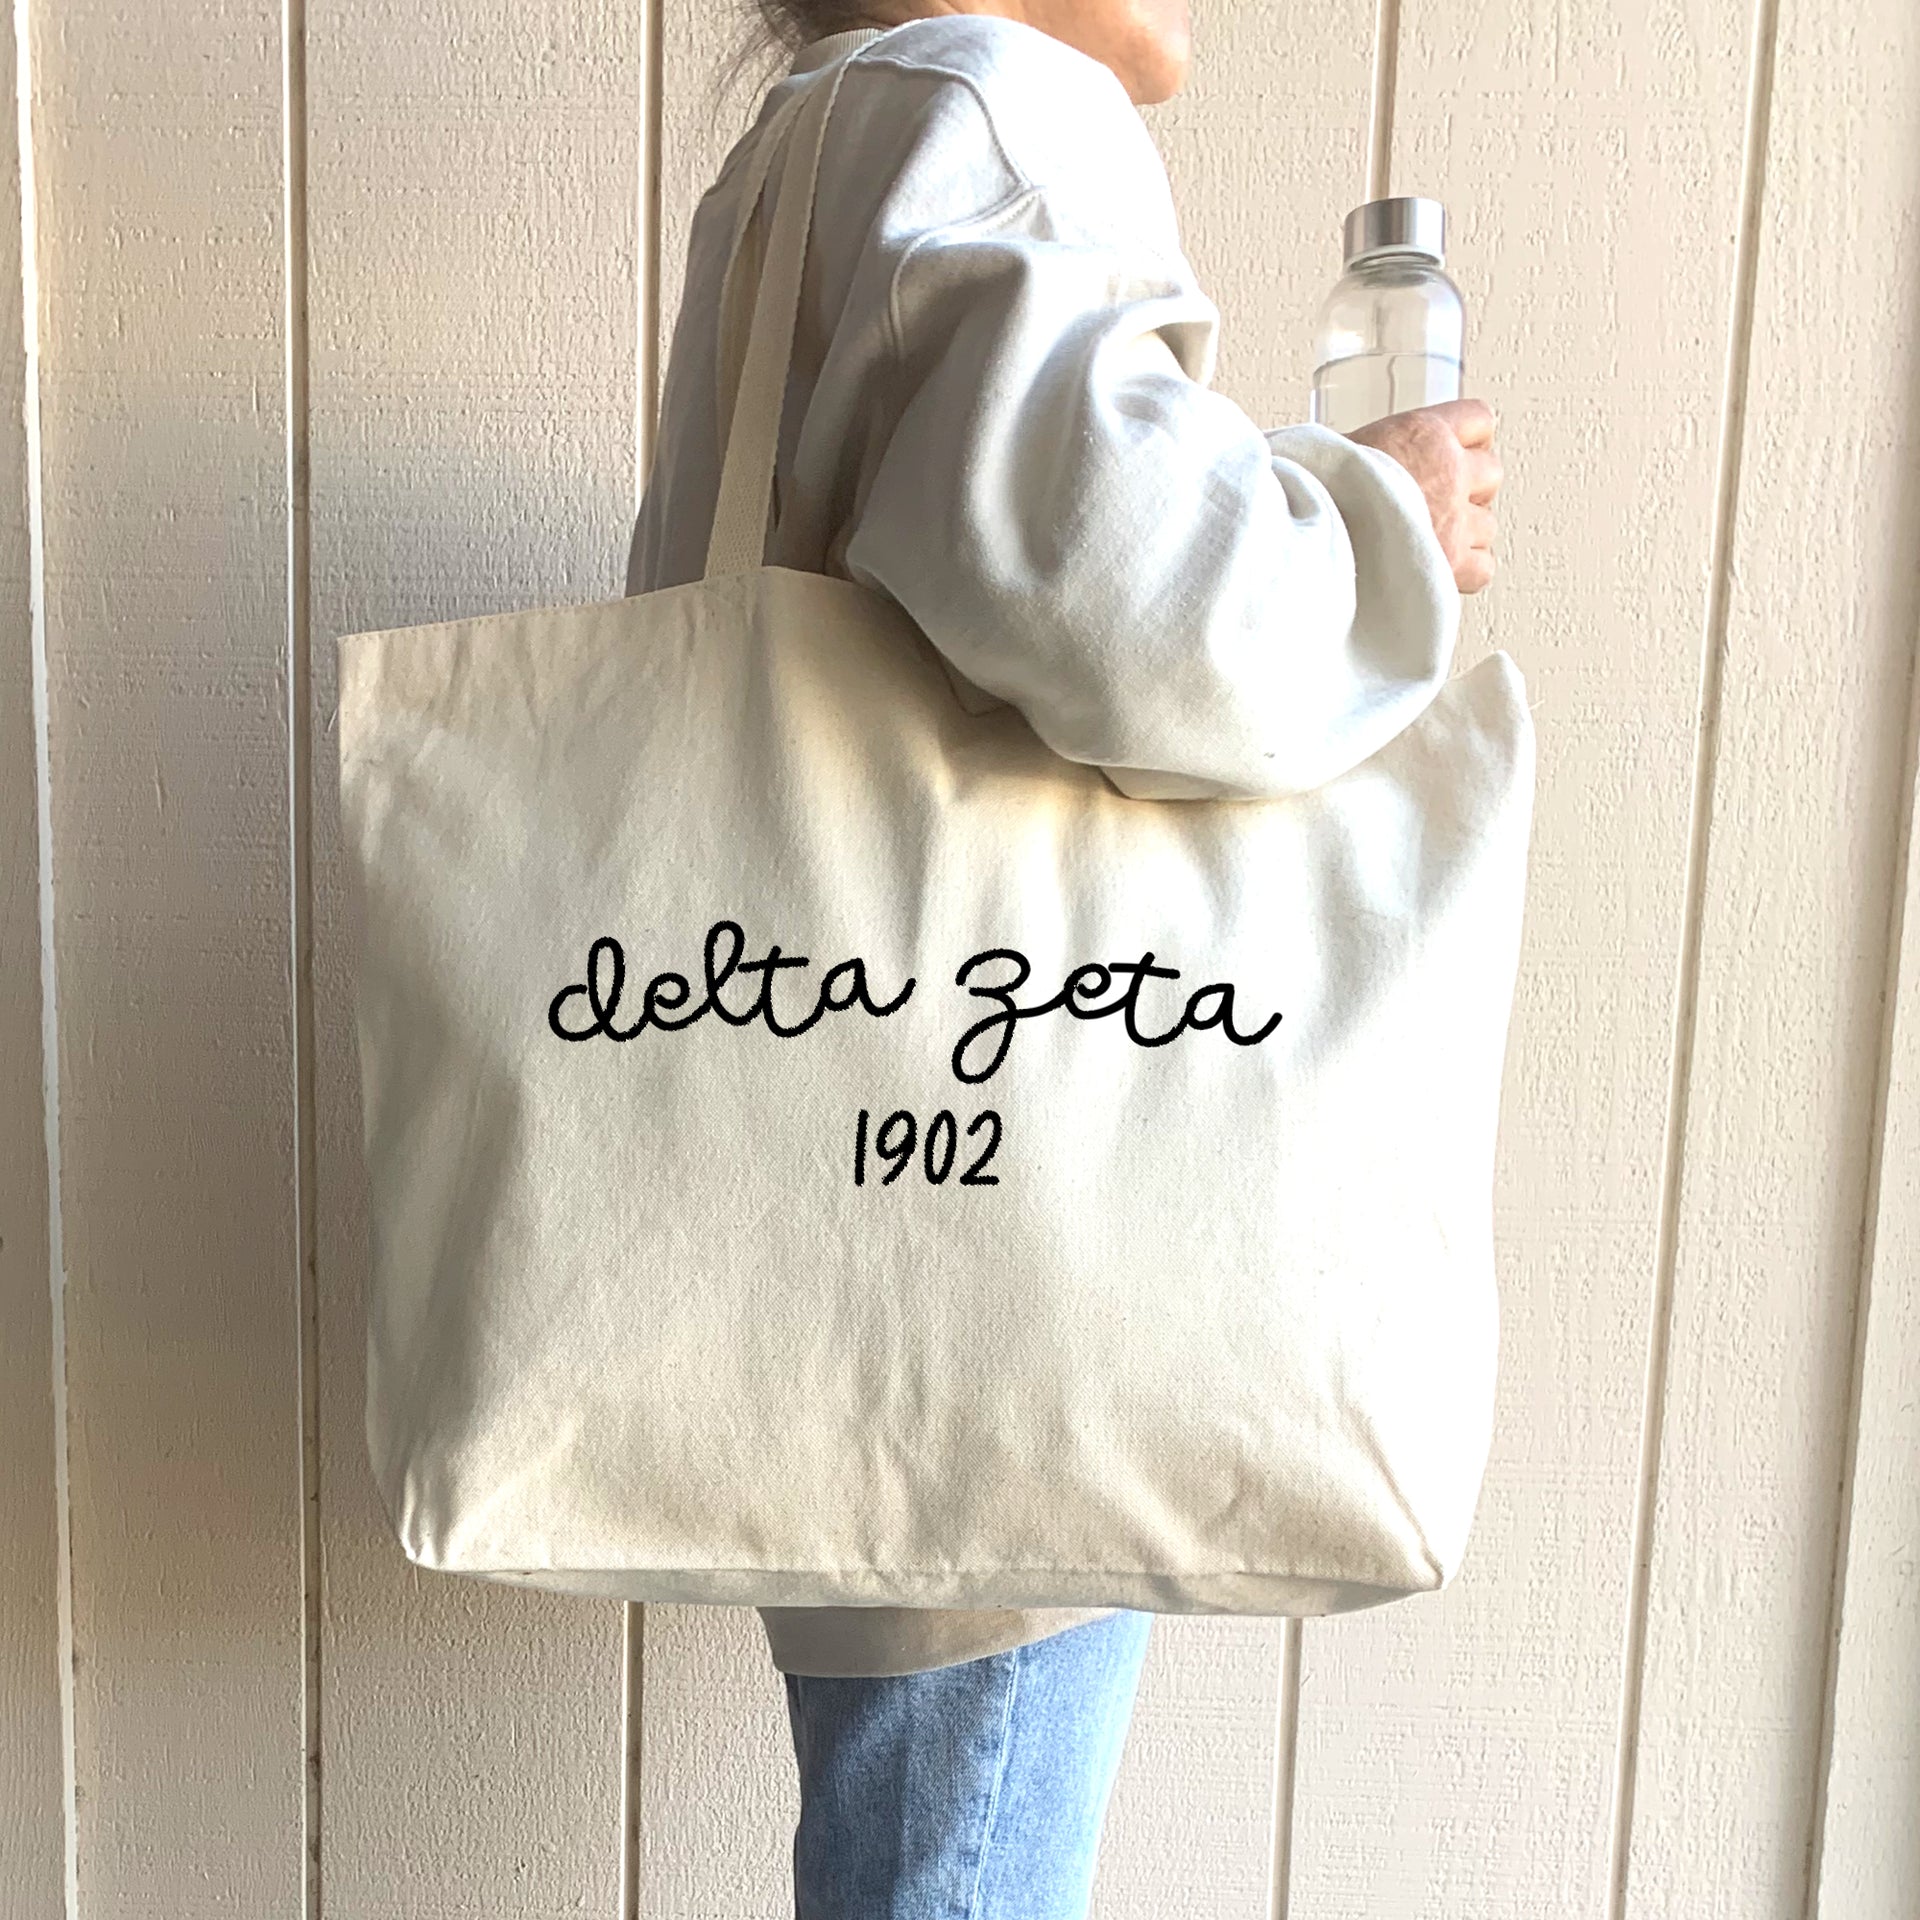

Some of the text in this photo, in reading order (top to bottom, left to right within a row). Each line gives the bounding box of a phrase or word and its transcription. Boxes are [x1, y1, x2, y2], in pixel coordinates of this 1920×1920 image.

[548, 920, 1283, 1085] delta zeta
[854, 1109, 1003, 1187] 1902
